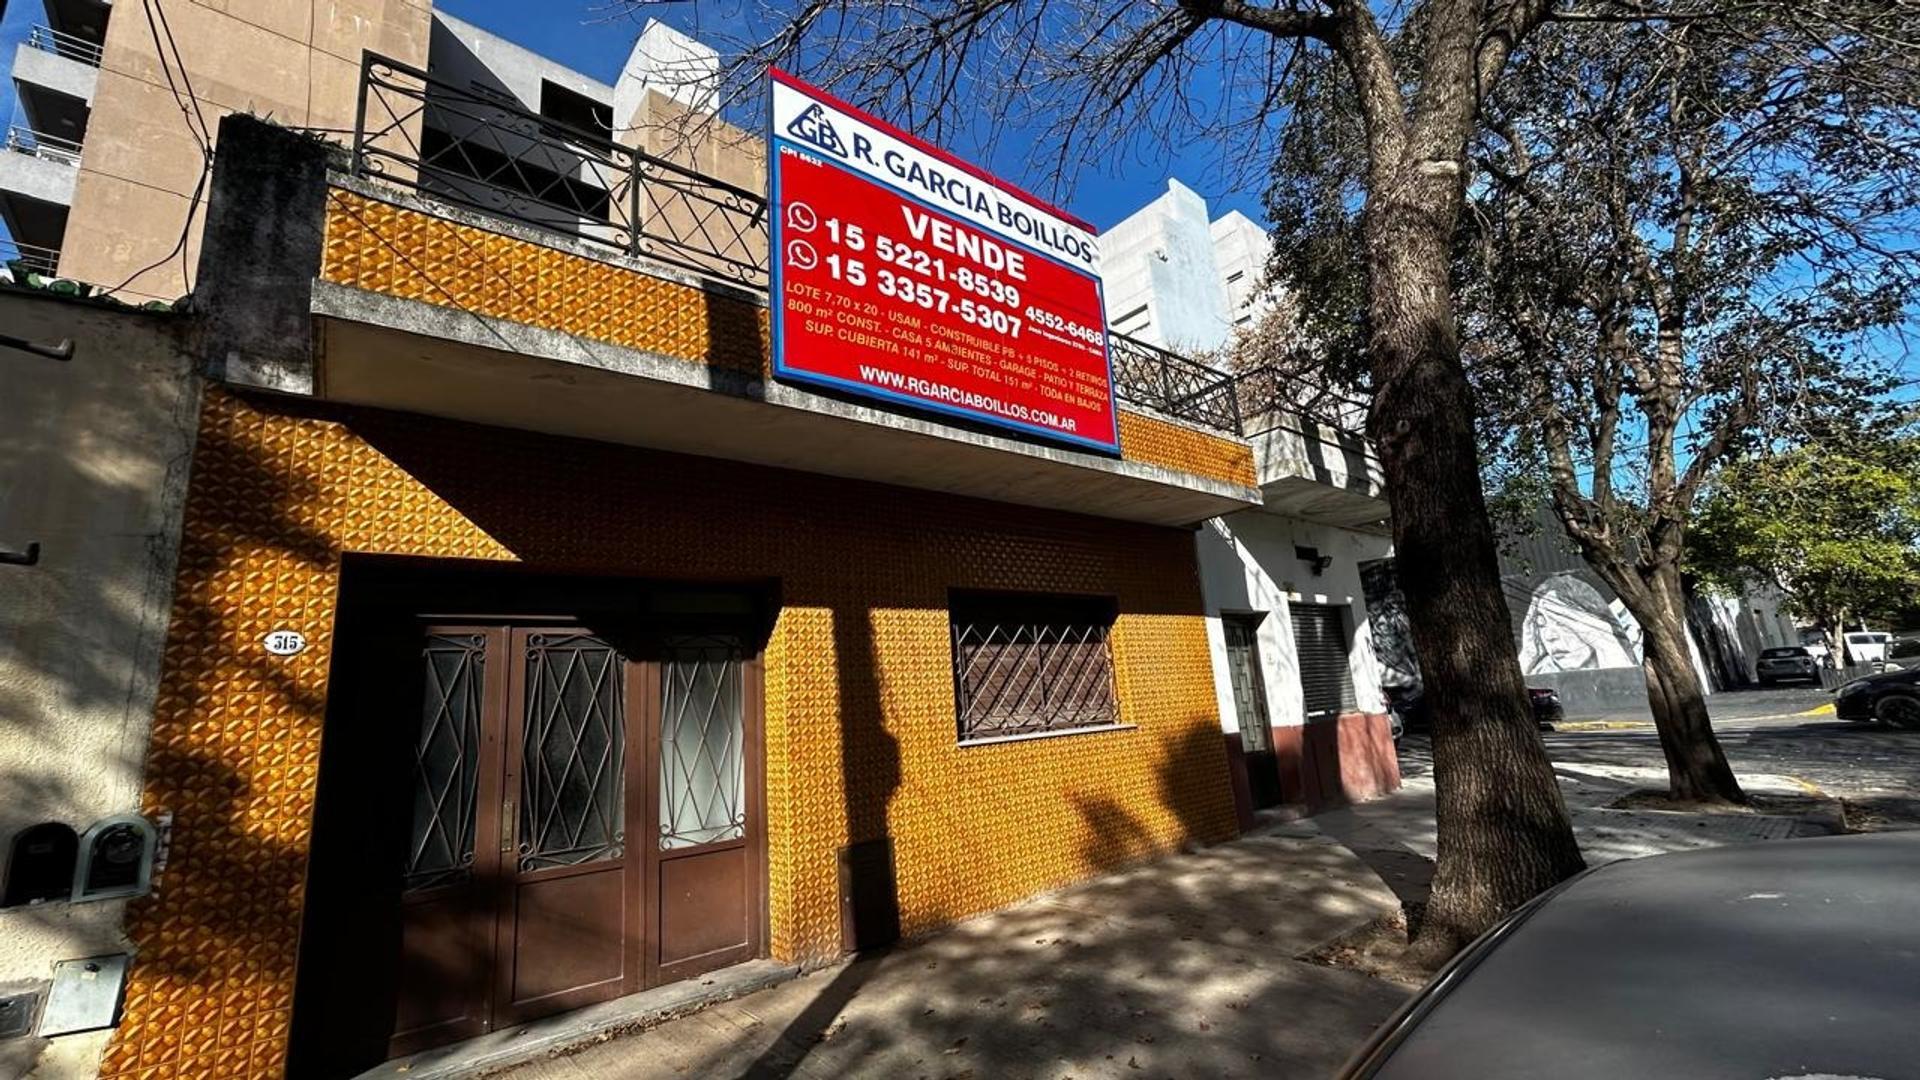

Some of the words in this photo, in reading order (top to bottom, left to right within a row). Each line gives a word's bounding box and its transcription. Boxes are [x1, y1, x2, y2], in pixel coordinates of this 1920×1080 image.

[798, 114, 837, 150] GB
[853, 132, 880, 167] R.
[884, 150, 993, 220] GARCIA
[997, 201, 1092, 263] BOILLOS
[825, 218, 865, 251] 15
[876, 235, 1020, 308] 5221-8539
[901, 205, 1027, 281] VENDE
[786, 280, 821, 300] LOTE
[863, 303, 878, 316] 20
[888, 310, 921, 329] USAM
[930, 324, 1001, 354] CONSTRUIBLE
[1002, 346, 1016, 359] PB
[1033, 356, 1059, 373] PISOS
[1069, 368, 1075, 377] 2
[826, 253, 867, 287] 15
[877, 269, 1021, 338] 3357-5307
[1025, 306, 1104, 346] 4552-6468
[788, 299, 813, 314] 800
[837, 311, 882, 333] CONST.
[892, 327, 922, 346] CASA
[925, 337, 932, 348] 5
[934, 340, 992, 364] AMBIENTES
[999, 360, 1037, 378] GARAGE
[1043, 372, 1068, 388] PATIO
[1075, 382, 1108, 401] TERRAZA
[805, 320, 834, 337] SUP.
[838, 328, 900, 354] CUBIERTA
[903, 346, 920, 360] 141
[972, 364, 1002, 382] TOTAL
[1004, 374, 1019, 388] 151
[1040, 384, 1063, 400] TODA
[1064, 393, 1075, 404] EN
[859, 364, 1076, 431] WWW.RGARCIABOILLOS.COM.AR
